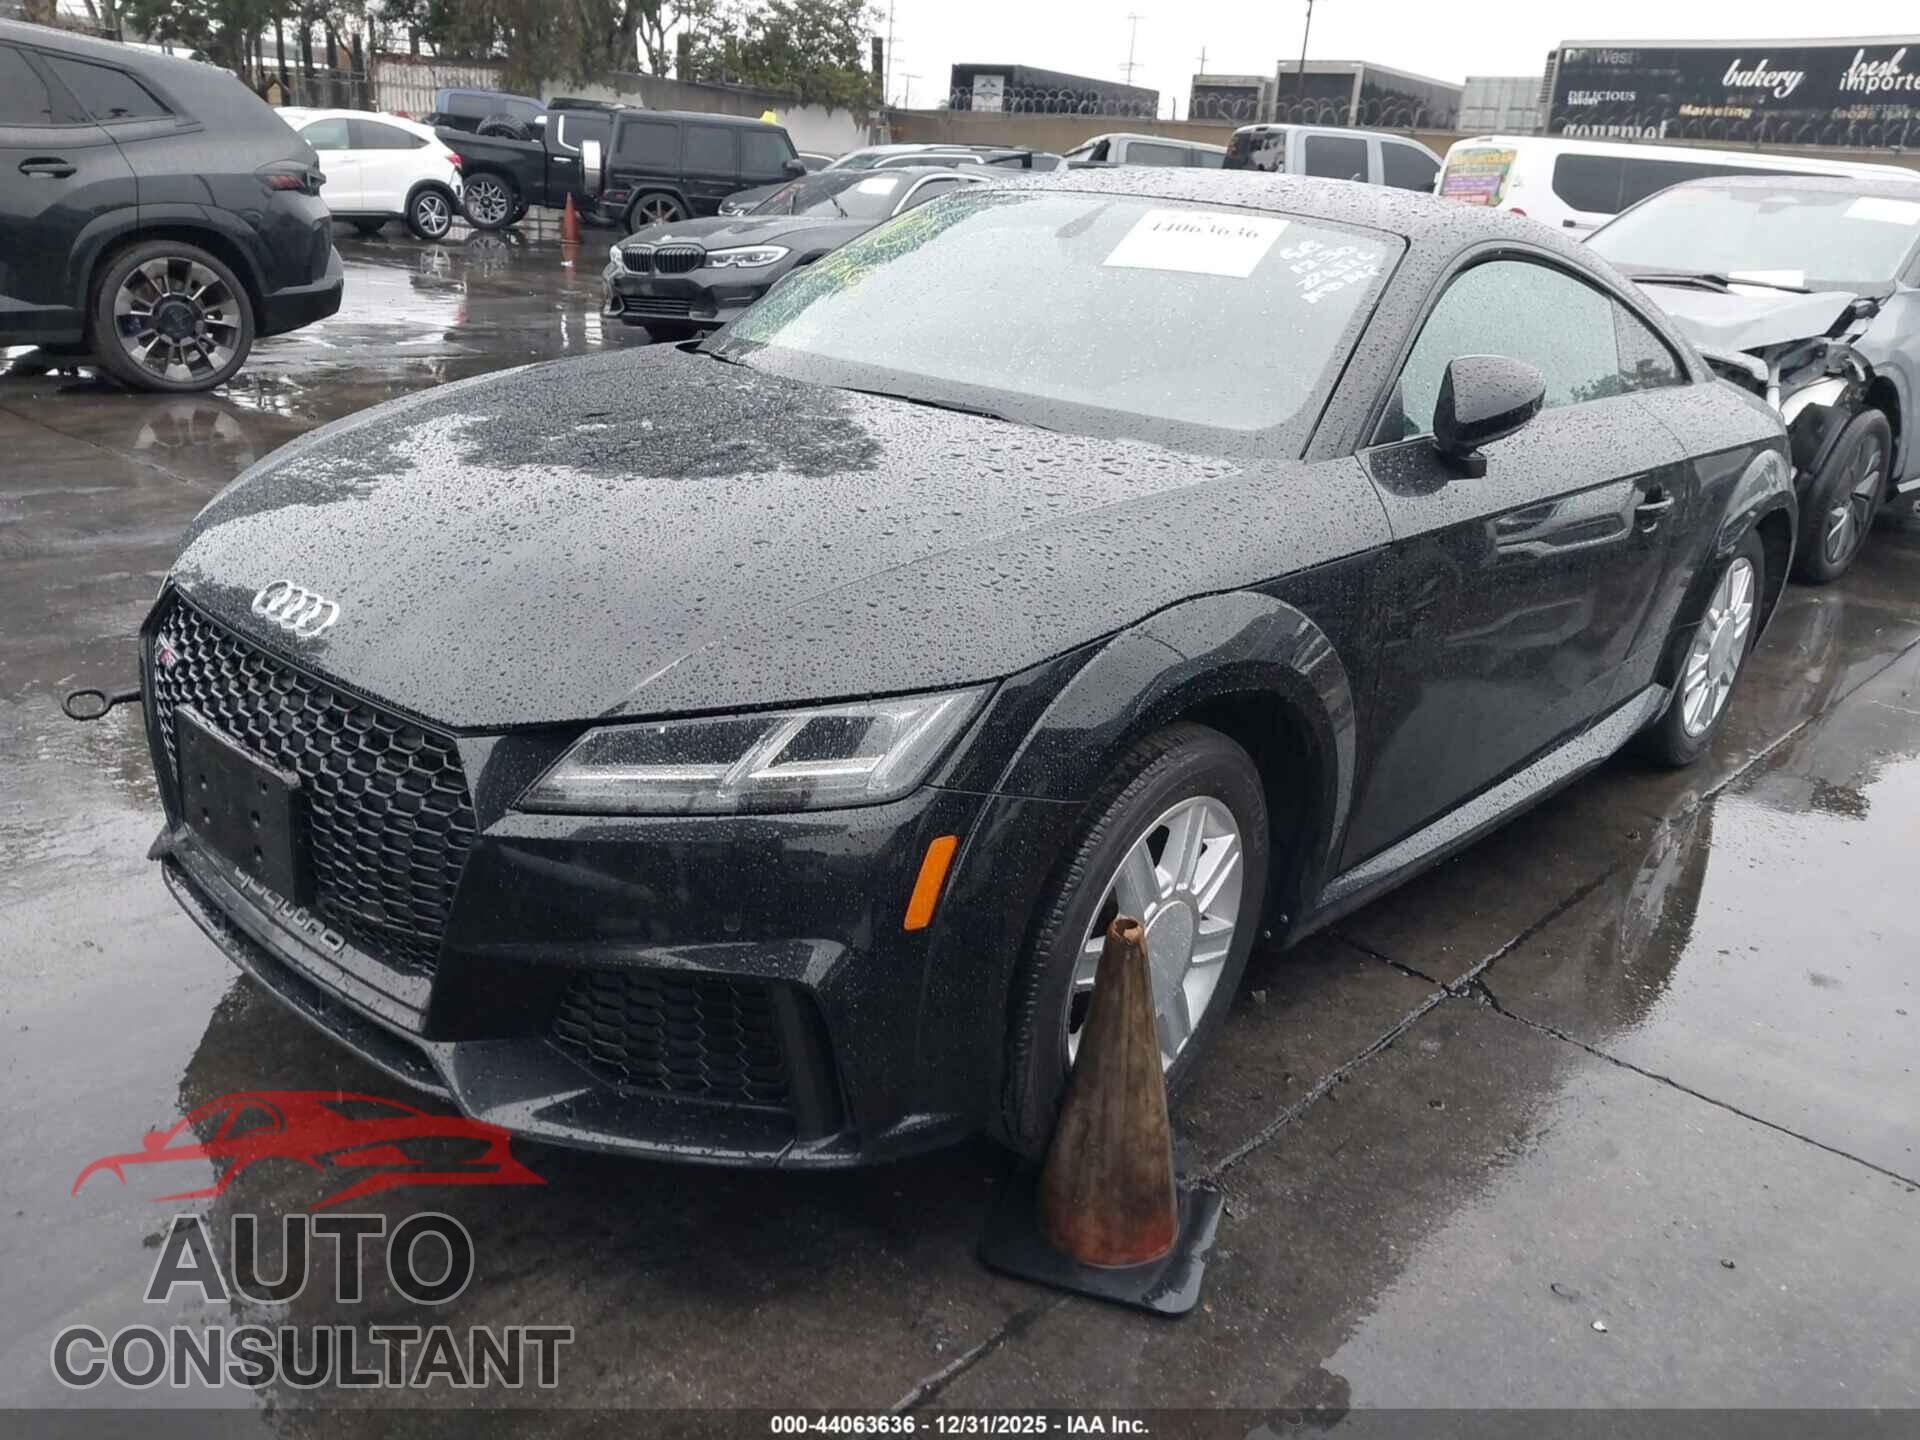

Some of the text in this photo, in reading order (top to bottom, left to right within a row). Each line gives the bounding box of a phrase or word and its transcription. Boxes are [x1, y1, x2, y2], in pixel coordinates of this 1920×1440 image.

[1722, 58, 1804, 99] bakery
[1567, 90, 1637, 102] DELICIOUS
[1679, 104, 1752, 119] Marketing
